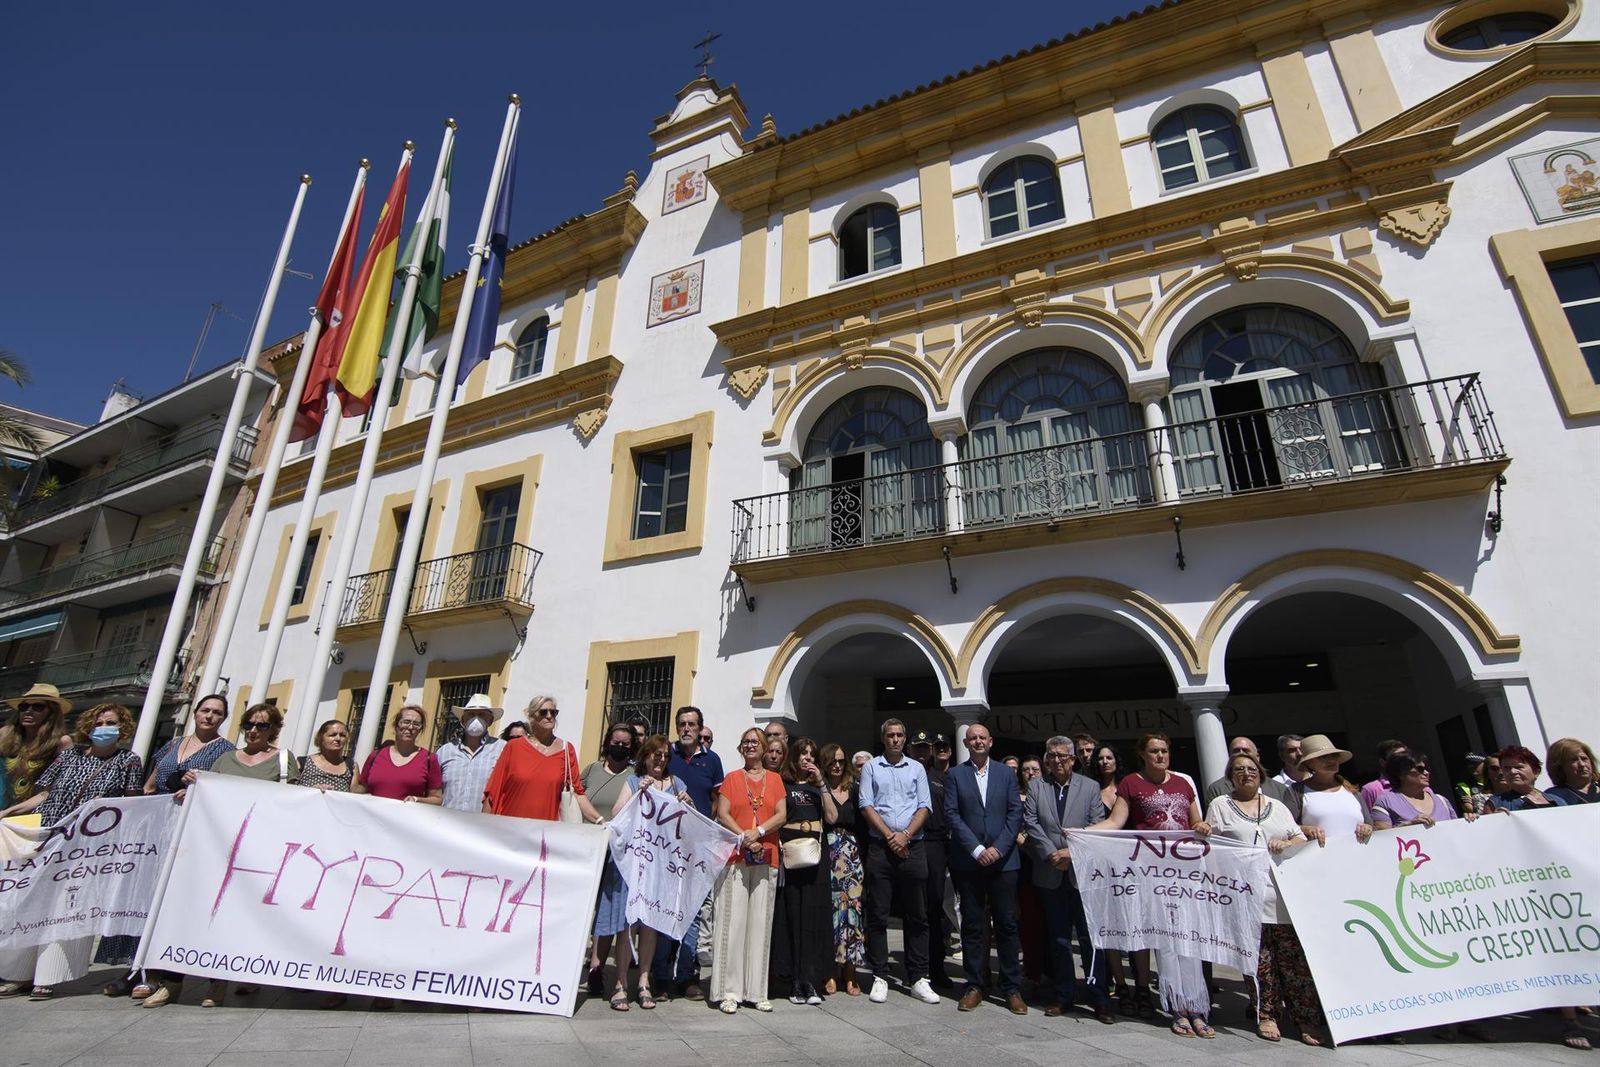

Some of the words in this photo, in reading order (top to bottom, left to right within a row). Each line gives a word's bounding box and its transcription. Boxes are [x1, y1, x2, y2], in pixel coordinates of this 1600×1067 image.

[34, 806, 122, 852] NO
[1129, 834, 1211, 862] NO
[4, 859, 37, 872] LA
[43, 842, 158, 866] VIOLENCIA
[0, 877, 30, 893] DE
[53, 862, 136, 882] GÉNERO
[208, 801, 548, 976] HYPATIA
[1091, 868, 1104, 881] A
[1111, 866, 1136, 879] LA
[1140, 865, 1254, 895] VIOLENCIA
[1112, 884, 1137, 897] DE
[1154, 881, 1233, 906] GÉNERO
[1409, 872, 1496, 902] Agrupación
[1498, 862, 1572, 886] Literaria
[1417, 898, 1491, 937] MARÍA
[1492, 889, 1592, 927] MUÑOZ
[1191, 930, 1209, 944] Dos
[1466, 923, 1600, 964] CRESPILLO
[160, 945, 280, 977] ASOCIACIÓN
[284, 962, 312, 980] DE
[316, 965, 407, 990] MUJERES
[411, 970, 562, 1005] FEMINISTAS
[1328, 1006, 1364, 1021] TODAS
[1365, 1002, 1387, 1014] LAS
[1389, 995, 1426, 1011] COSAS
[1429, 990, 1454, 1004] SON
[1456, 979, 1523, 1000] IMPOSIBLES,
[1524, 972, 1592, 989] MIENTRAS
